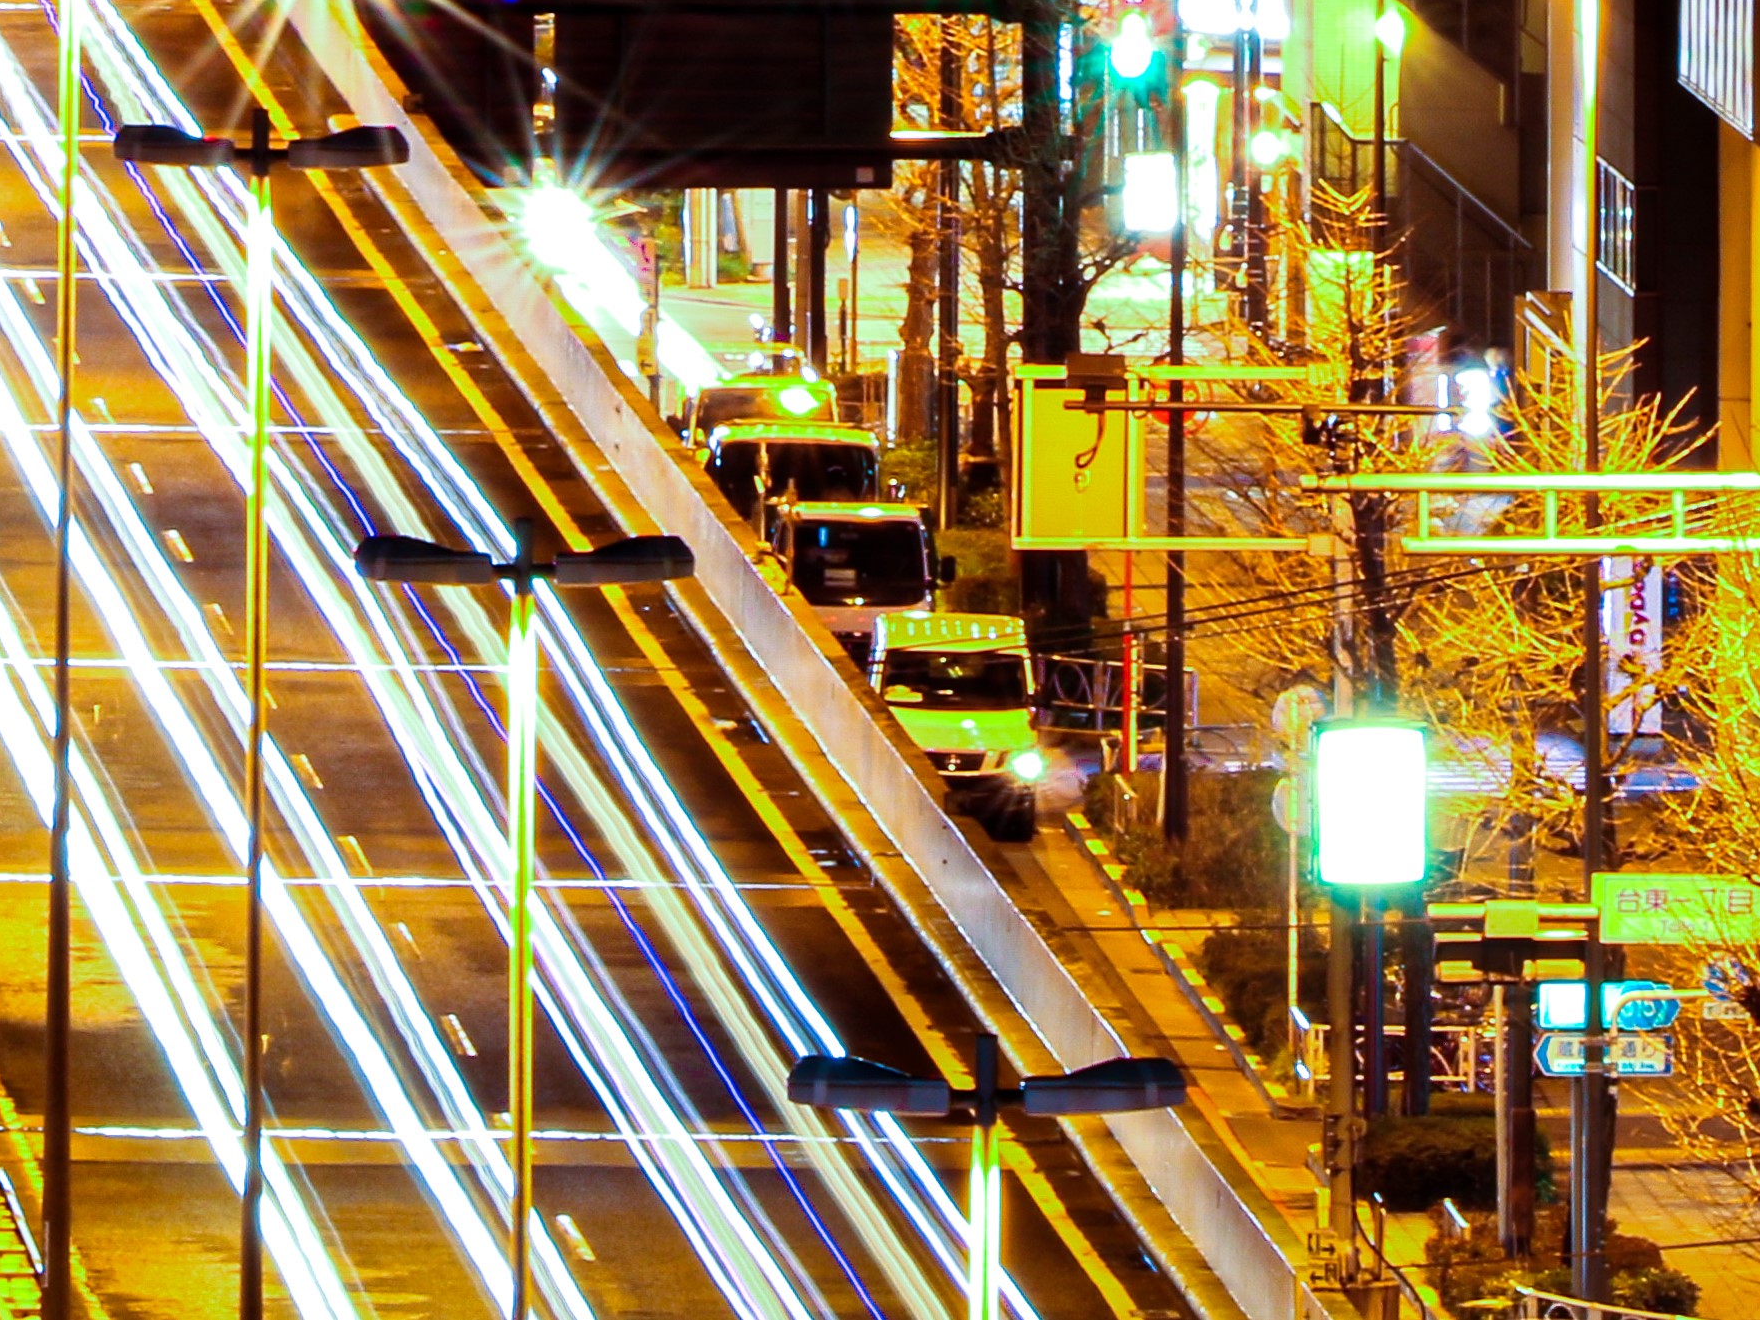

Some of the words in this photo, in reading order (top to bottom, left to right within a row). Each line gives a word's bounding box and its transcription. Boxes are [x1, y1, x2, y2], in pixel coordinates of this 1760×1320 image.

[1616, 888, 1754, 915] 台東一丁目
[1556, 1040, 1656, 1060] 蔵通り
